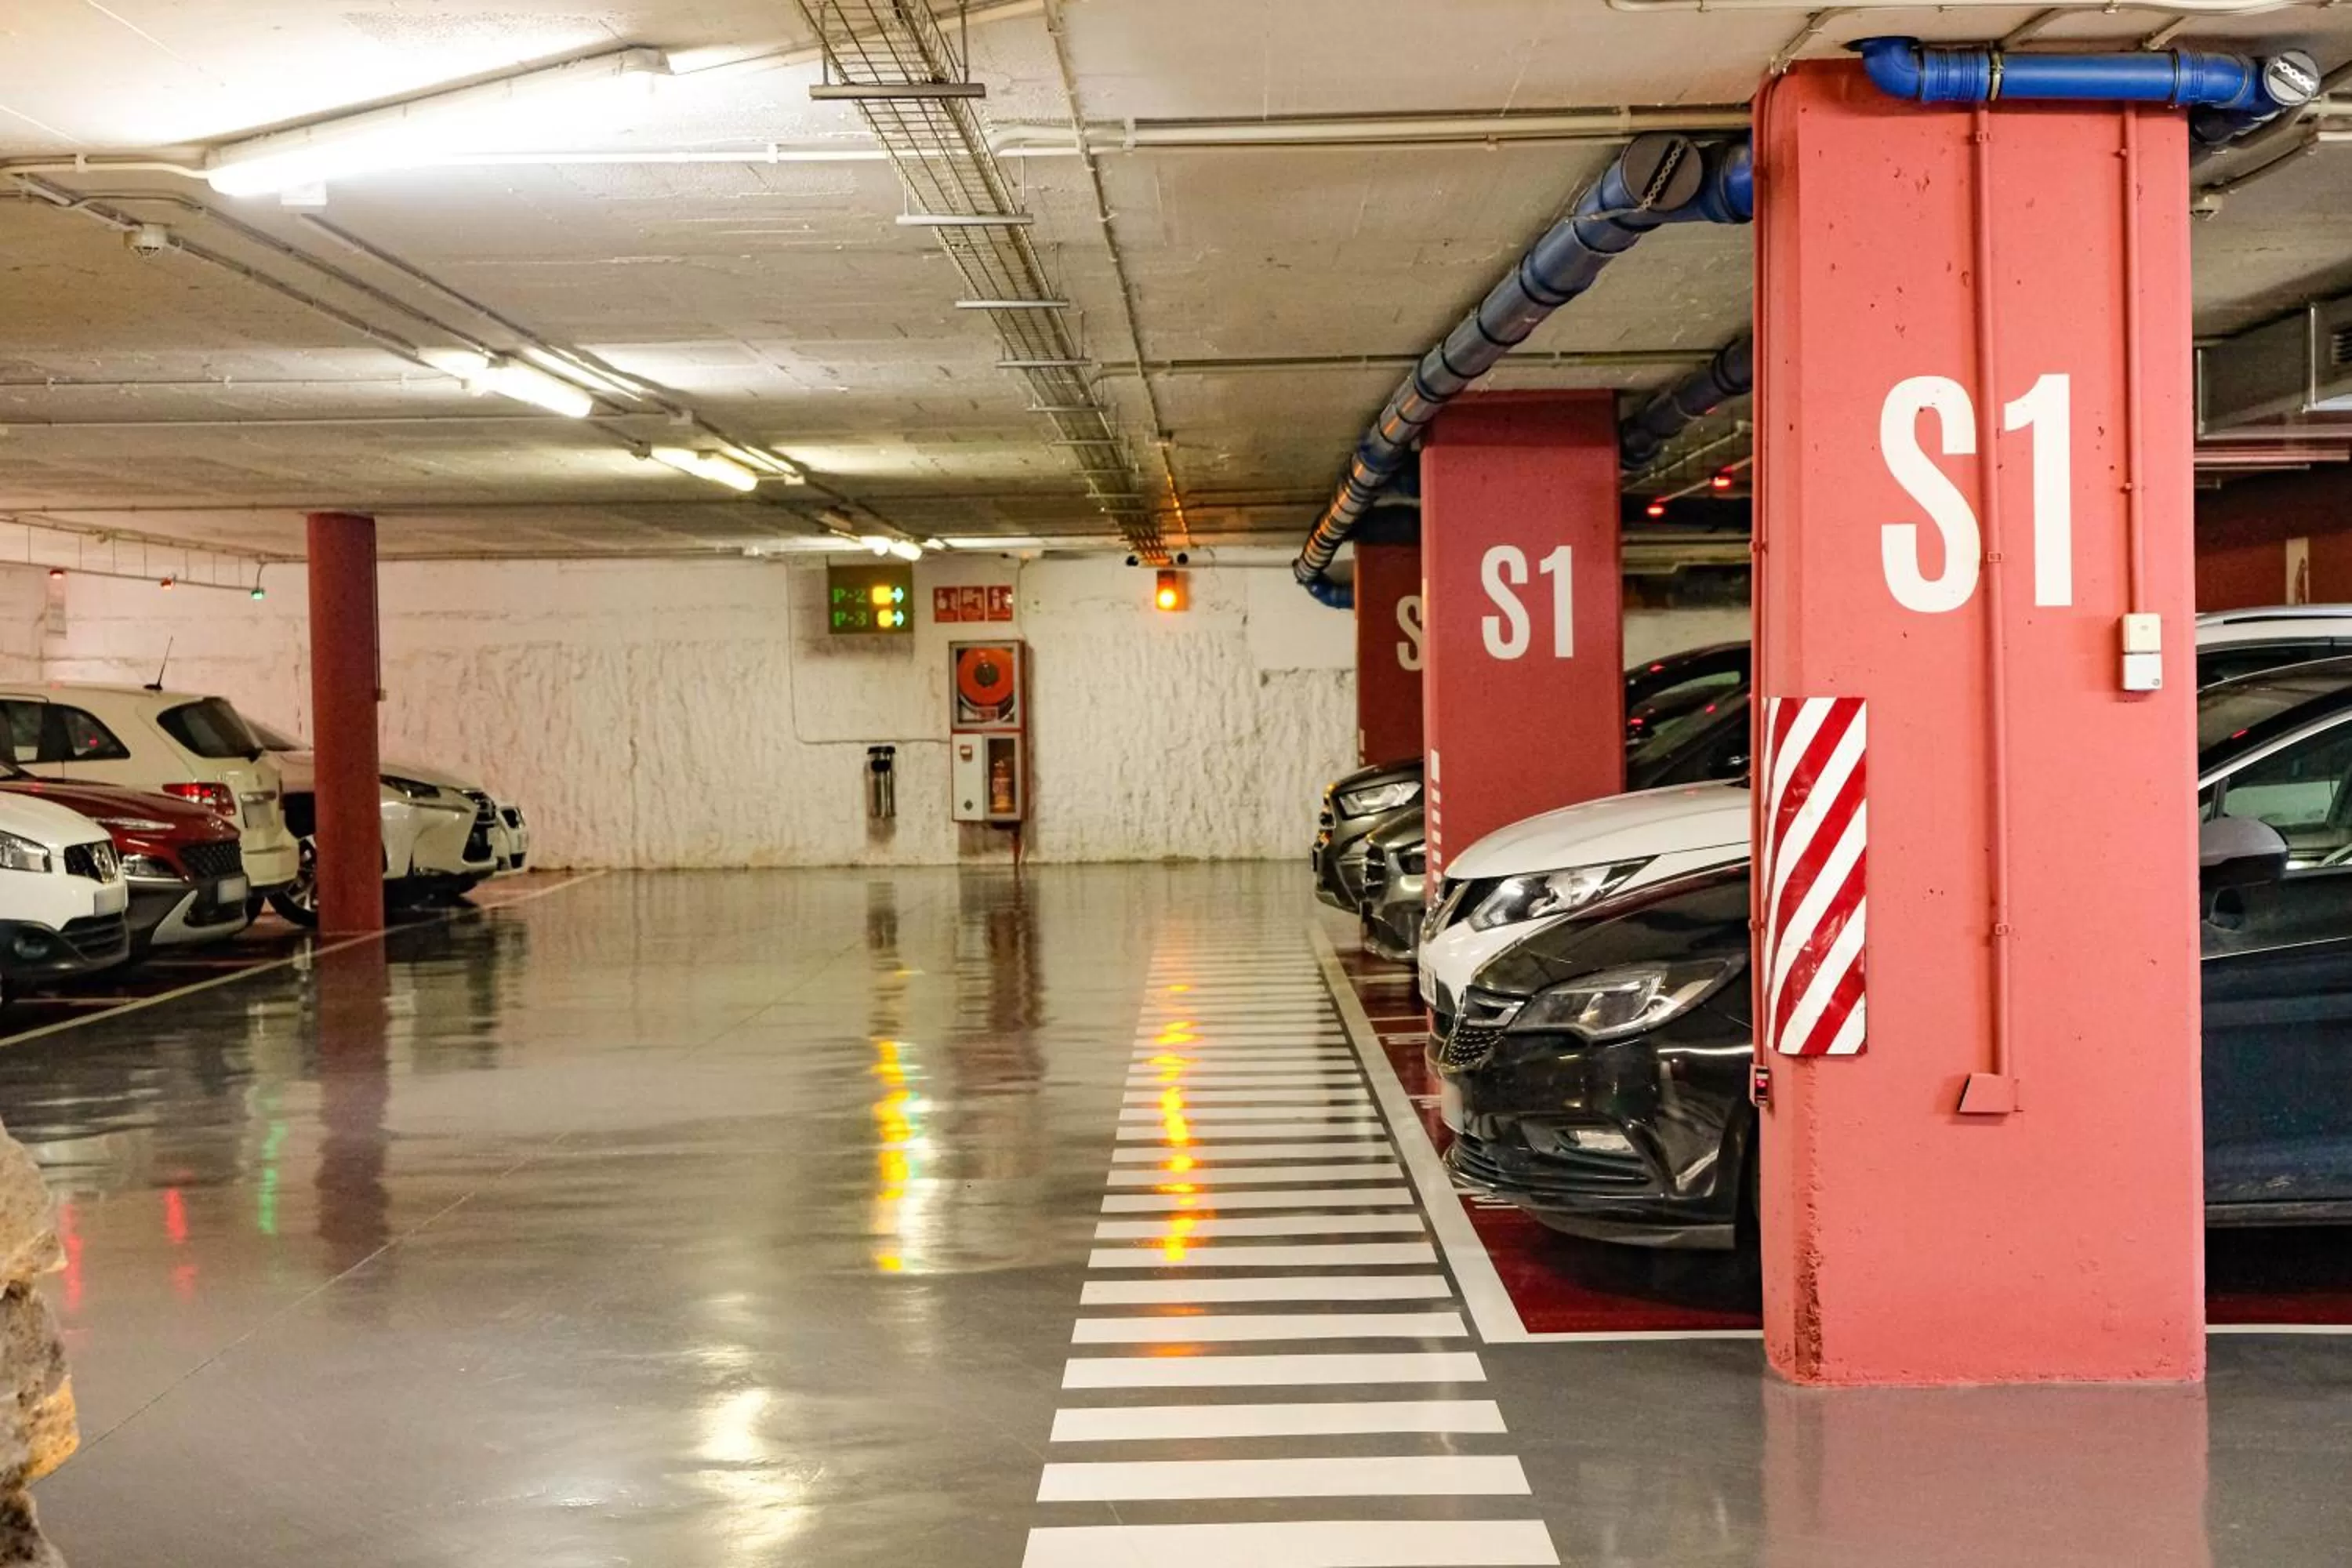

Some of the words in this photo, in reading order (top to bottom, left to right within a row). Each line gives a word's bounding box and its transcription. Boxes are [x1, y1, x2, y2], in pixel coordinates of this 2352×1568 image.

[1880, 373, 2072, 612] S1
[1396, 595, 1422, 671] S
[1480, 545, 1573, 659] S1
